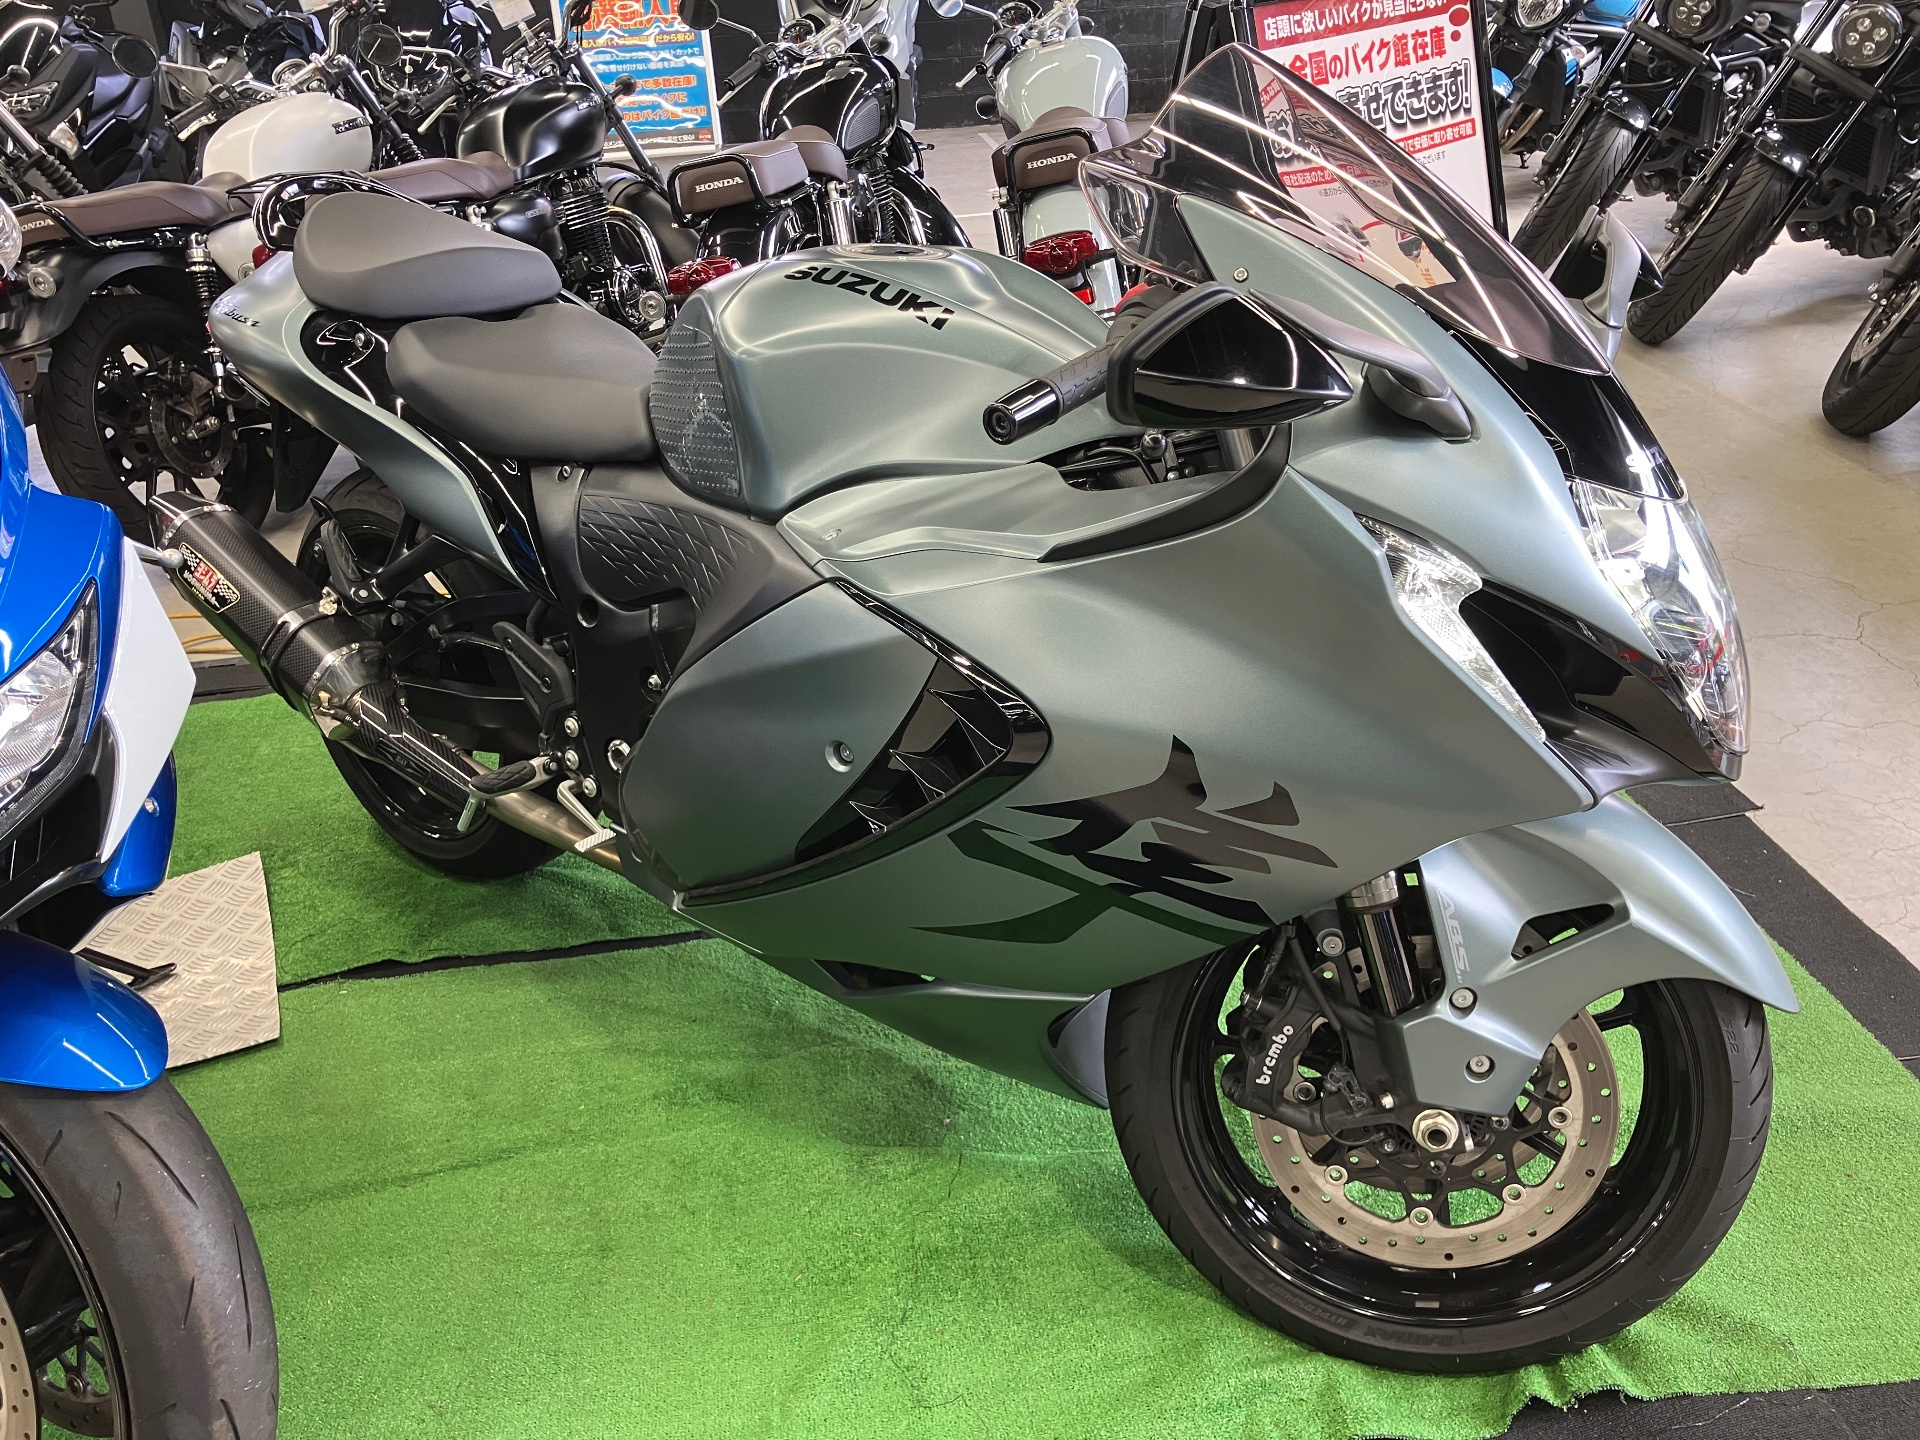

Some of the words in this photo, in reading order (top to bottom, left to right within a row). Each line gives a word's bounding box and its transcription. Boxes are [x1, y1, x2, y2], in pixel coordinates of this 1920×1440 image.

[1289, 26, 1447, 86] 全国のバイク館在庫
[694, 175, 744, 193] HONDA
[1026, 152, 1078, 170] HONDA
[21, 218, 55, 232] ONDA
[784, 266, 955, 331] SUZUKI
[1435, 886, 1470, 977] ABS
[1255, 1024, 1294, 1085] brembo
